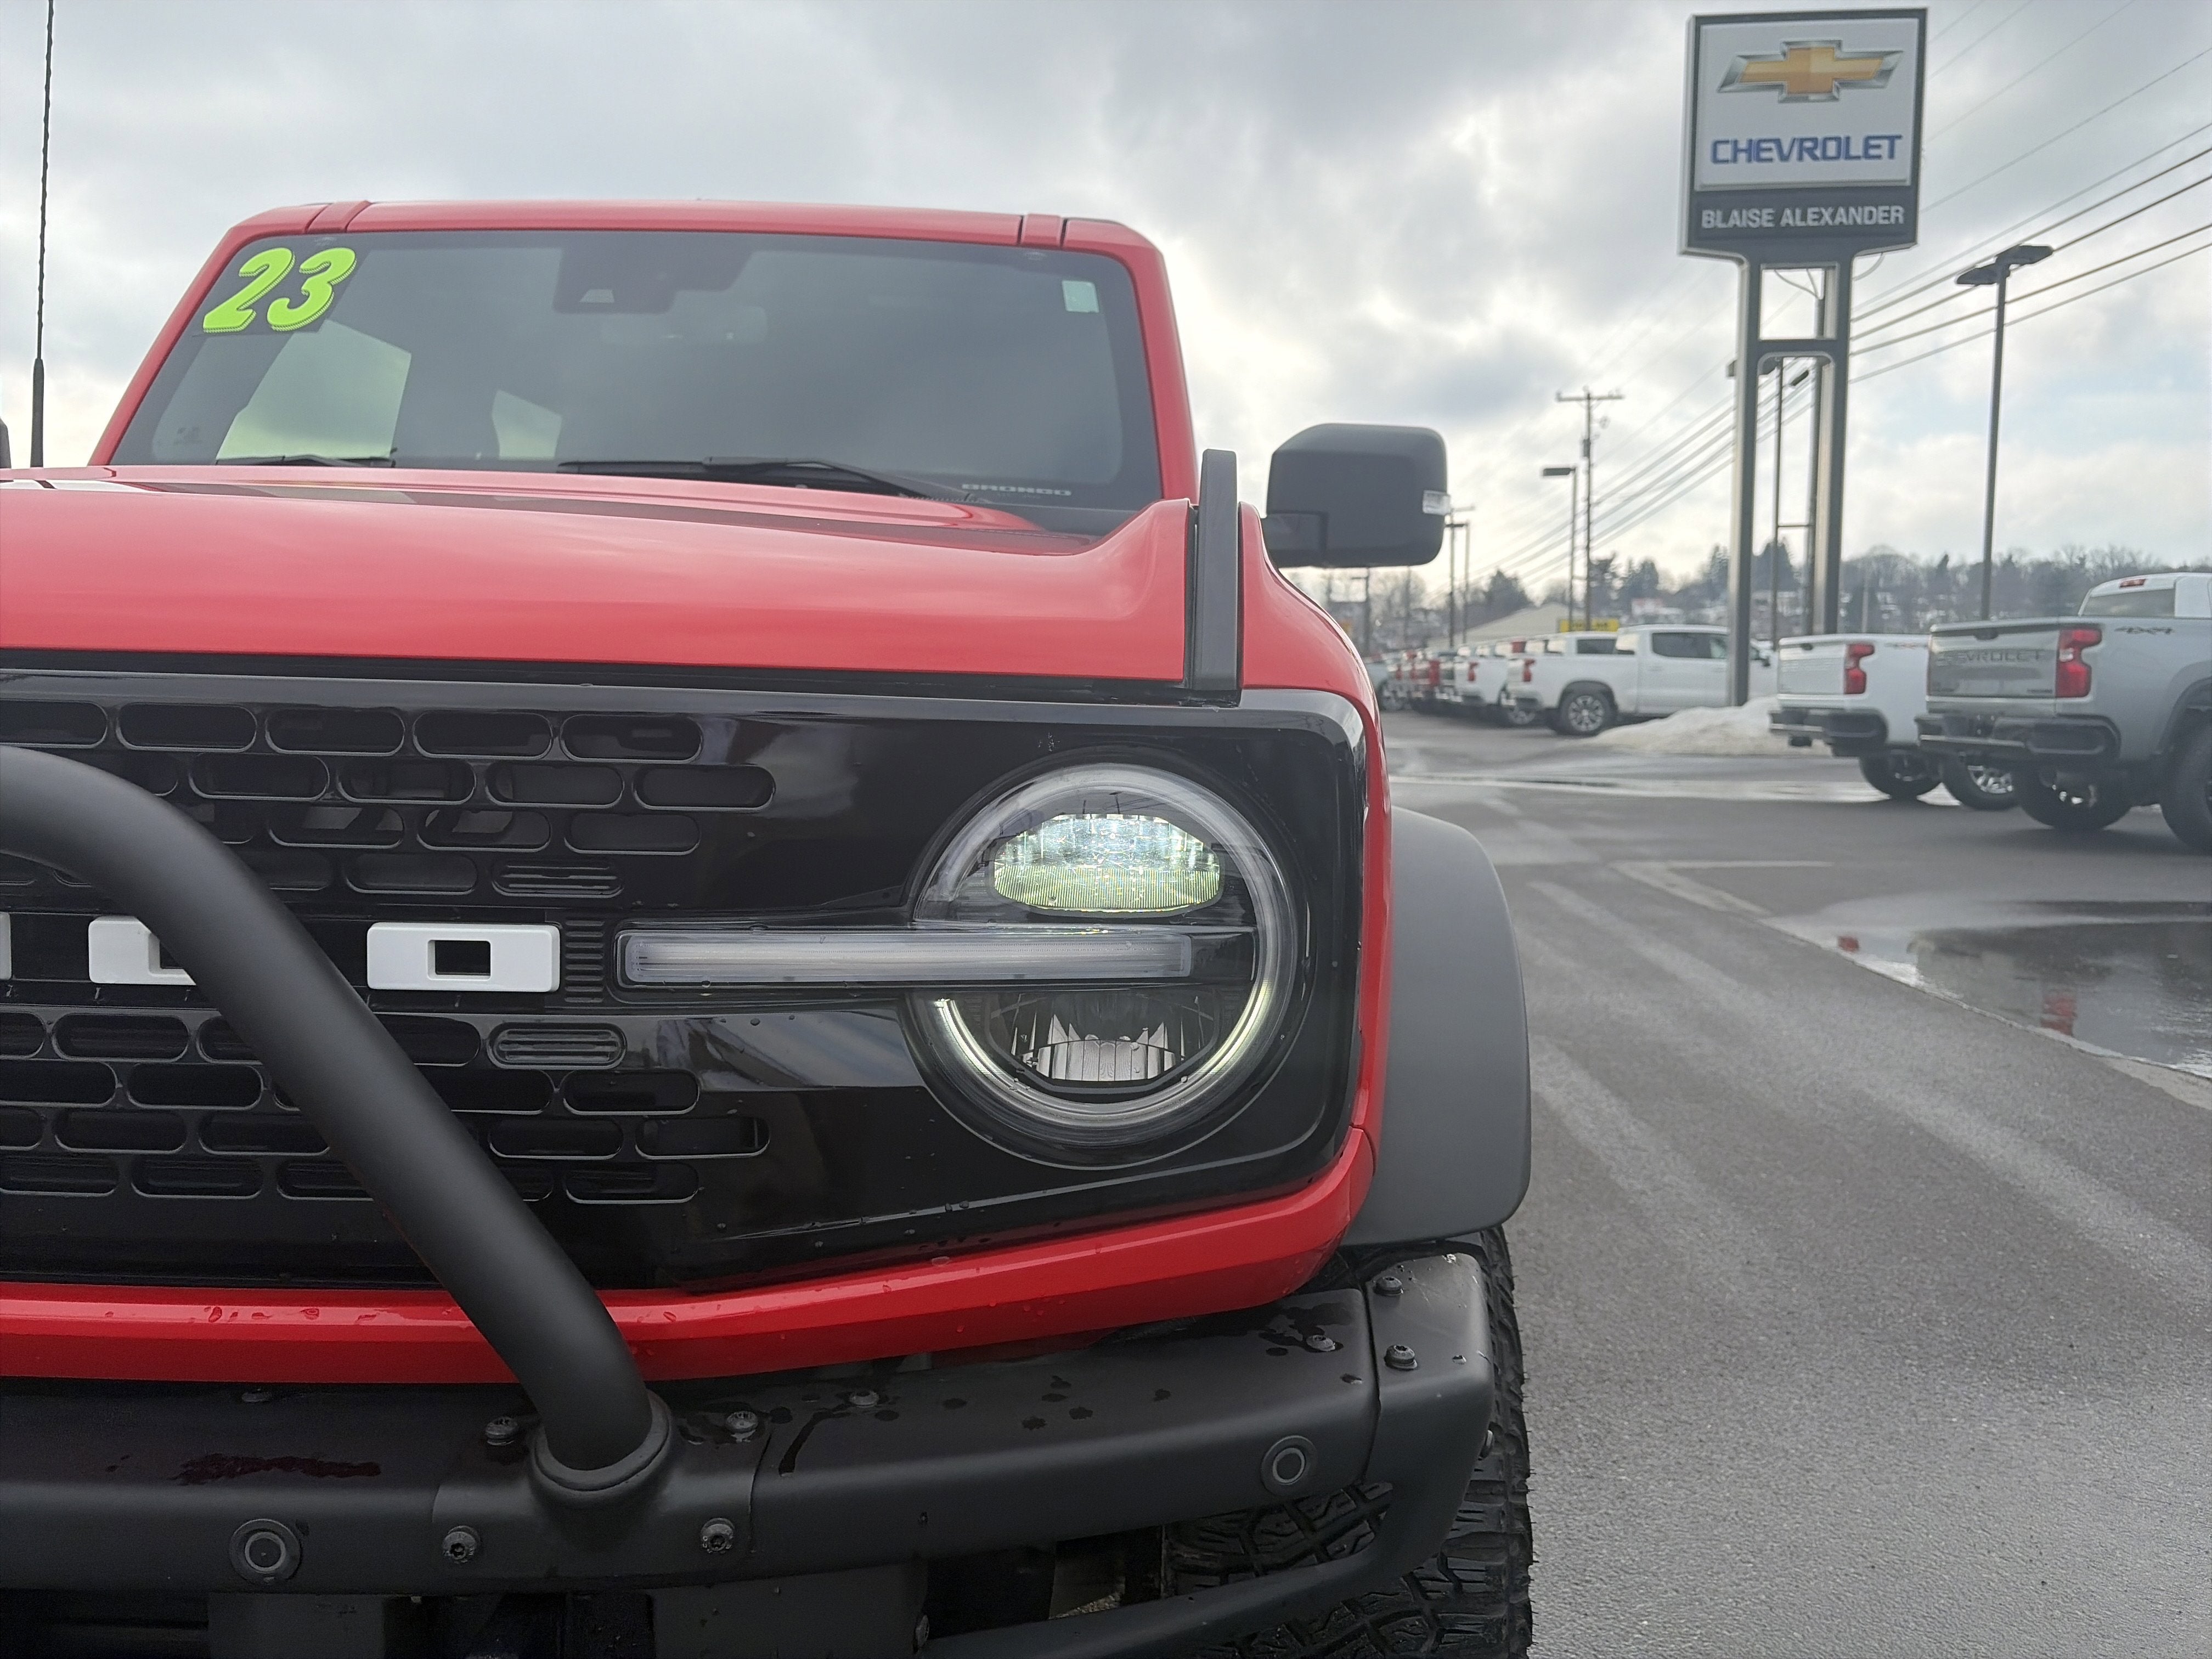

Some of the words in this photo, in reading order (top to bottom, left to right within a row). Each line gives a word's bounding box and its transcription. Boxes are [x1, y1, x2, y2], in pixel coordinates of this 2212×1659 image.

[1711, 134, 1903, 164] CHEVROLET
[1702, 207, 1775, 228] BLAISE
[1780, 205, 1904, 227] ALEXANDER
[202, 247, 357, 333] 23
[1935, 649, 2046, 666] EVROLET
